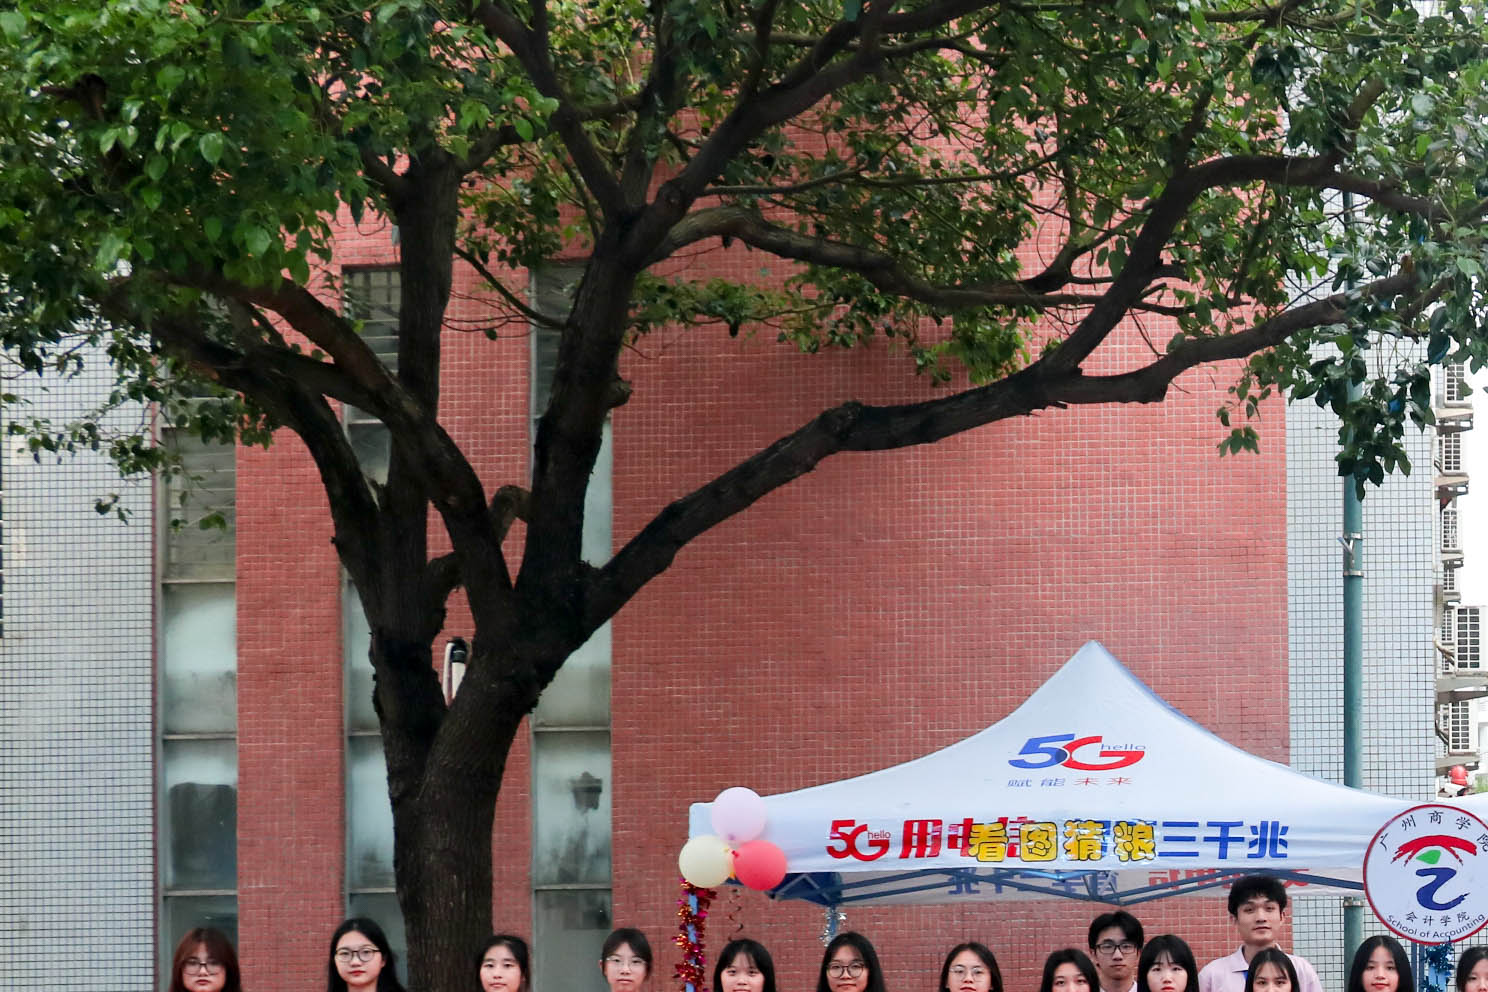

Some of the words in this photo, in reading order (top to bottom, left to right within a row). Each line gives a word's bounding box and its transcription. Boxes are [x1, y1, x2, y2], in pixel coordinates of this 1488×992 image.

[1008, 733, 1145, 771] 5G
[1101, 743, 1146, 751] hello
[826, 819, 890, 862] 5G
[867, 829, 892, 840] hello
[968, 819, 1156, 862] 看图猜粮
[1386, 914, 1417, 936] School
[1419, 930, 1430, 938] of
[1432, 913, 1486, 938] Accounting
[1405, 911, 1471, 927] 会计学院
